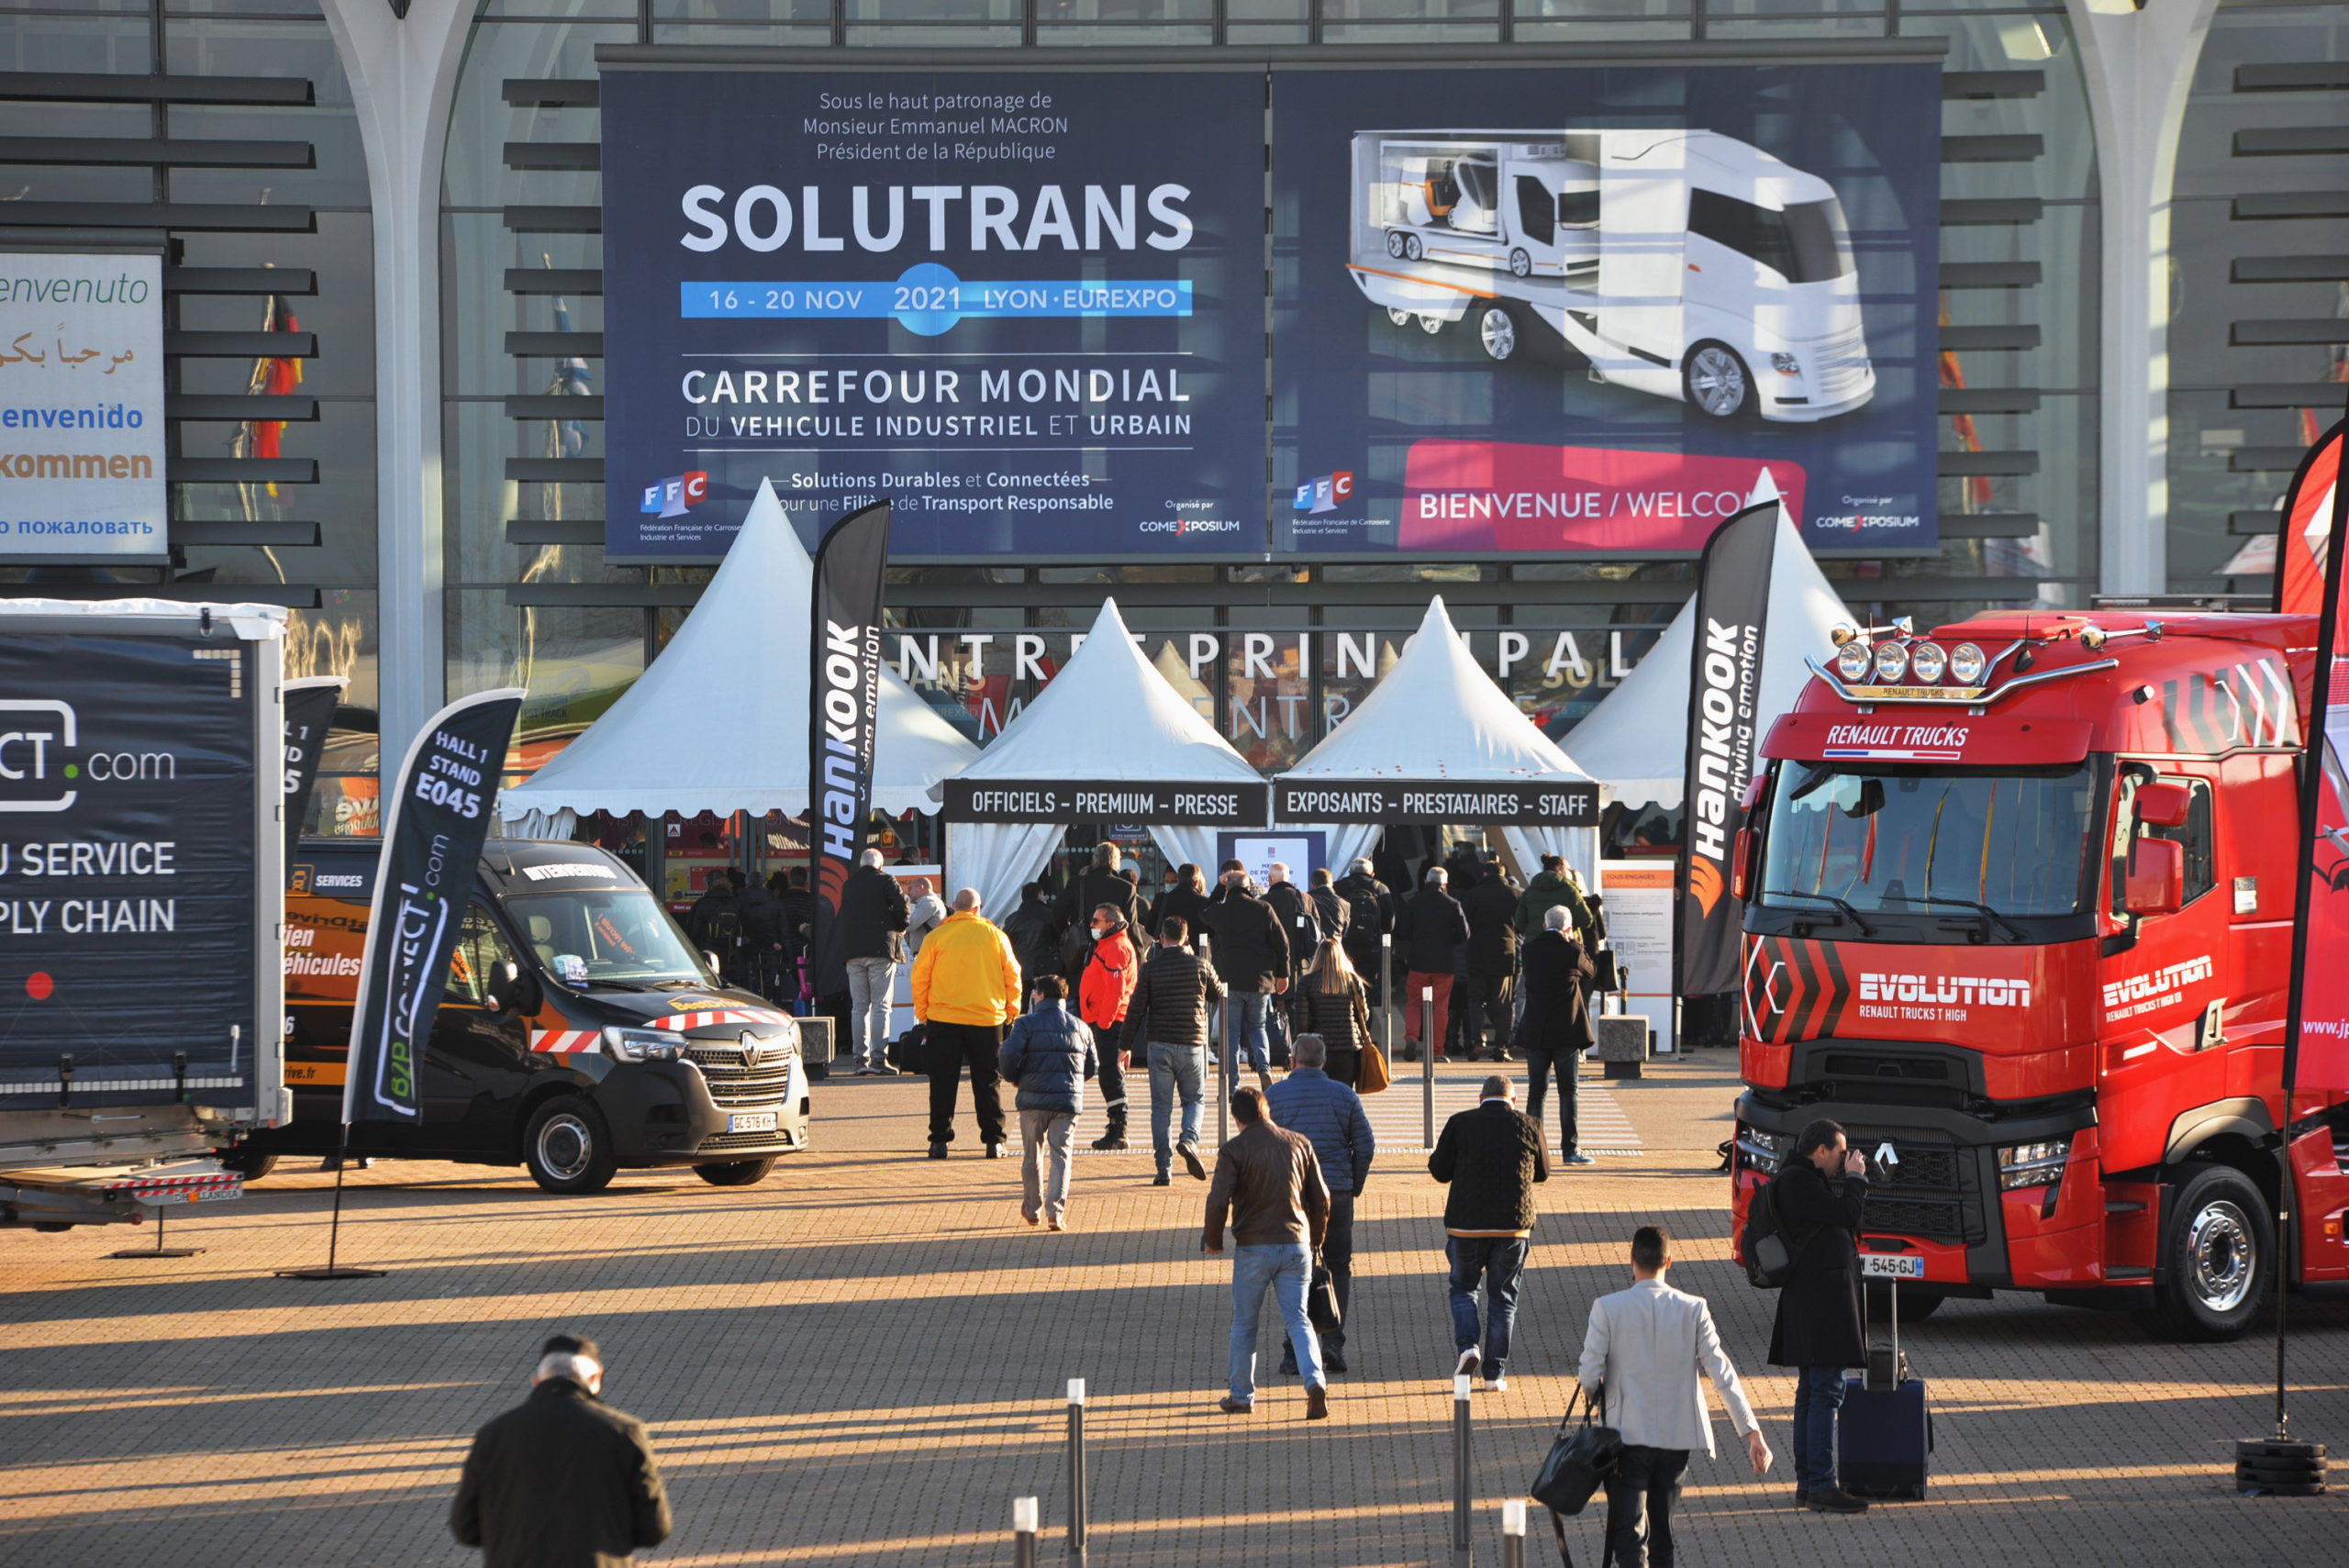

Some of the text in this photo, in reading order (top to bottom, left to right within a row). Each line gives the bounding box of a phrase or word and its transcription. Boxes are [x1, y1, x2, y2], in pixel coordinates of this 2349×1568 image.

[819, 91, 1052, 113] Sous le haut patronage de
[804, 117, 1068, 134] Monsieur Emmanuel MACRON
[817, 141, 1055, 163] Président de la République
[680, 183, 1193, 253] SOLUTRANS
[709, 289, 739, 310] 16
[766, 289, 796, 310] 20
[805, 288, 863, 310] NOV
[894, 286, 960, 310] 2021
[683, 368, 1190, 404] CARREFOUR MONDIAL
[2, 404, 143, 428] envenido
[686, 414, 1191, 437] DU VEHICULE INDUSTRIEL ET URBAIN
[0, 454, 152, 478] kommen
[645, 477, 704, 506] FFC
[792, 471, 1090, 488] Solutions Durables et Connectées
[1297, 476, 1351, 503] FFC
[779, 498, 806, 512] our
[809, 498, 839, 511] une
[898, 495, 918, 511] de
[922, 495, 1003, 513] Transport
[1008, 494, 1114, 514] Responsable
[1164, 500, 1214, 511] Organisé par
[1420, 492, 1600, 517] BIENVENUE
[1842, 495, 1893, 506] Organisé par
[18, 520, 153, 534] пожаловать
[640, 524, 674, 532] Fédération
[674, 524, 703, 532] Française
[704, 524, 712, 532] de
[1293, 517, 1322, 527] Fédération
[1323, 518, 1351, 527] Française
[1352, 518, 1358, 527] de
[862, 626, 880, 718] emotion
[1883, 687, 1944, 697] RENAULT TRUCKS
[1727, 624, 1759, 803] driving emotion
[435, 730, 488, 763] HALL 1
[1826, 725, 1969, 747] RENAULT TRUCKS
[430, 754, 482, 786] STAND
[415, 772, 482, 818] E045
[972, 791, 1055, 814] OFFICIELS
[1075, 792, 1153, 815] PREMIUM
[1174, 794, 1238, 816] PRESSE
[1287, 792, 1382, 814] EXPOSANTS
[1403, 793, 1519, 815] PRESTATAIRES
[1539, 795, 1588, 816] STAFF
[22, 842, 175, 876] SERVICE
[315, 874, 362, 887] SERVICES
[61, 900, 174, 933] CHAIN
[1860, 973, 2031, 1007] EVOLUTION
[2102, 955, 2213, 1007] EVOLUTION
[1860, 1006, 1966, 1022] RENAULT TRUCKS T HIGH
[2106, 1006, 2133, 1023] RENAULT
[2133, 1000, 2156, 1016] TRUCKS
[390, 1041, 411, 1097] B2P
